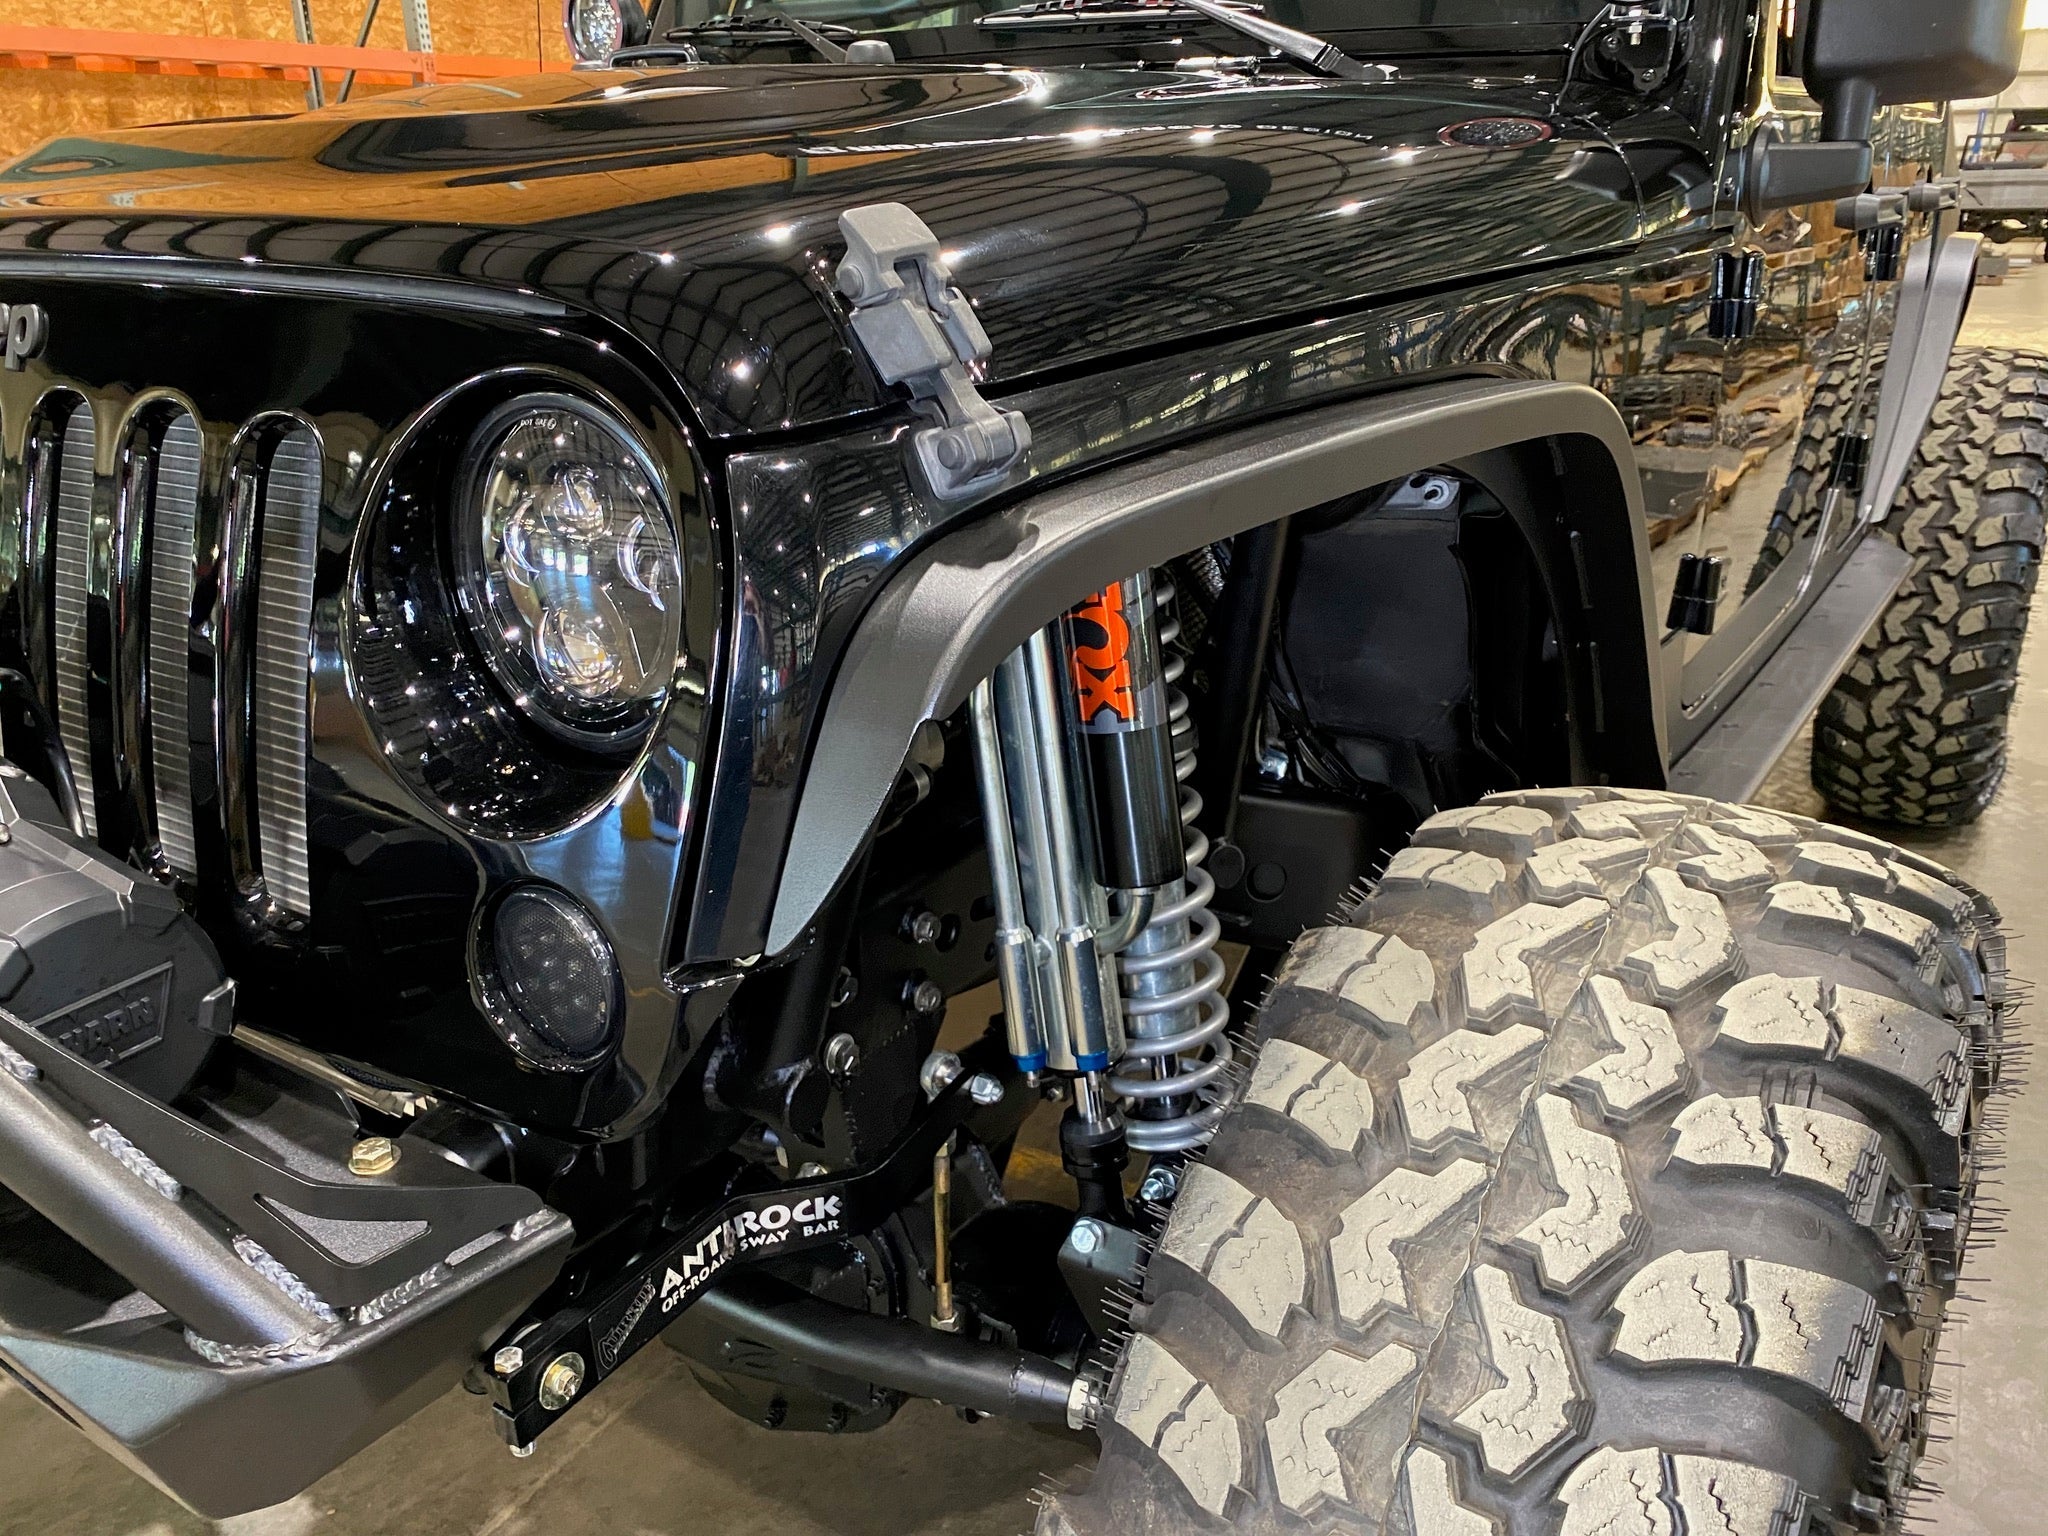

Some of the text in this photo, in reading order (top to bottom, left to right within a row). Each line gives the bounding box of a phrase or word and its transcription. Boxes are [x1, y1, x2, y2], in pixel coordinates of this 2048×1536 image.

[1064, 581, 1137, 723] OX
[739, 1228, 790, 1252] SWAY
[802, 1219, 840, 1237] BAR
